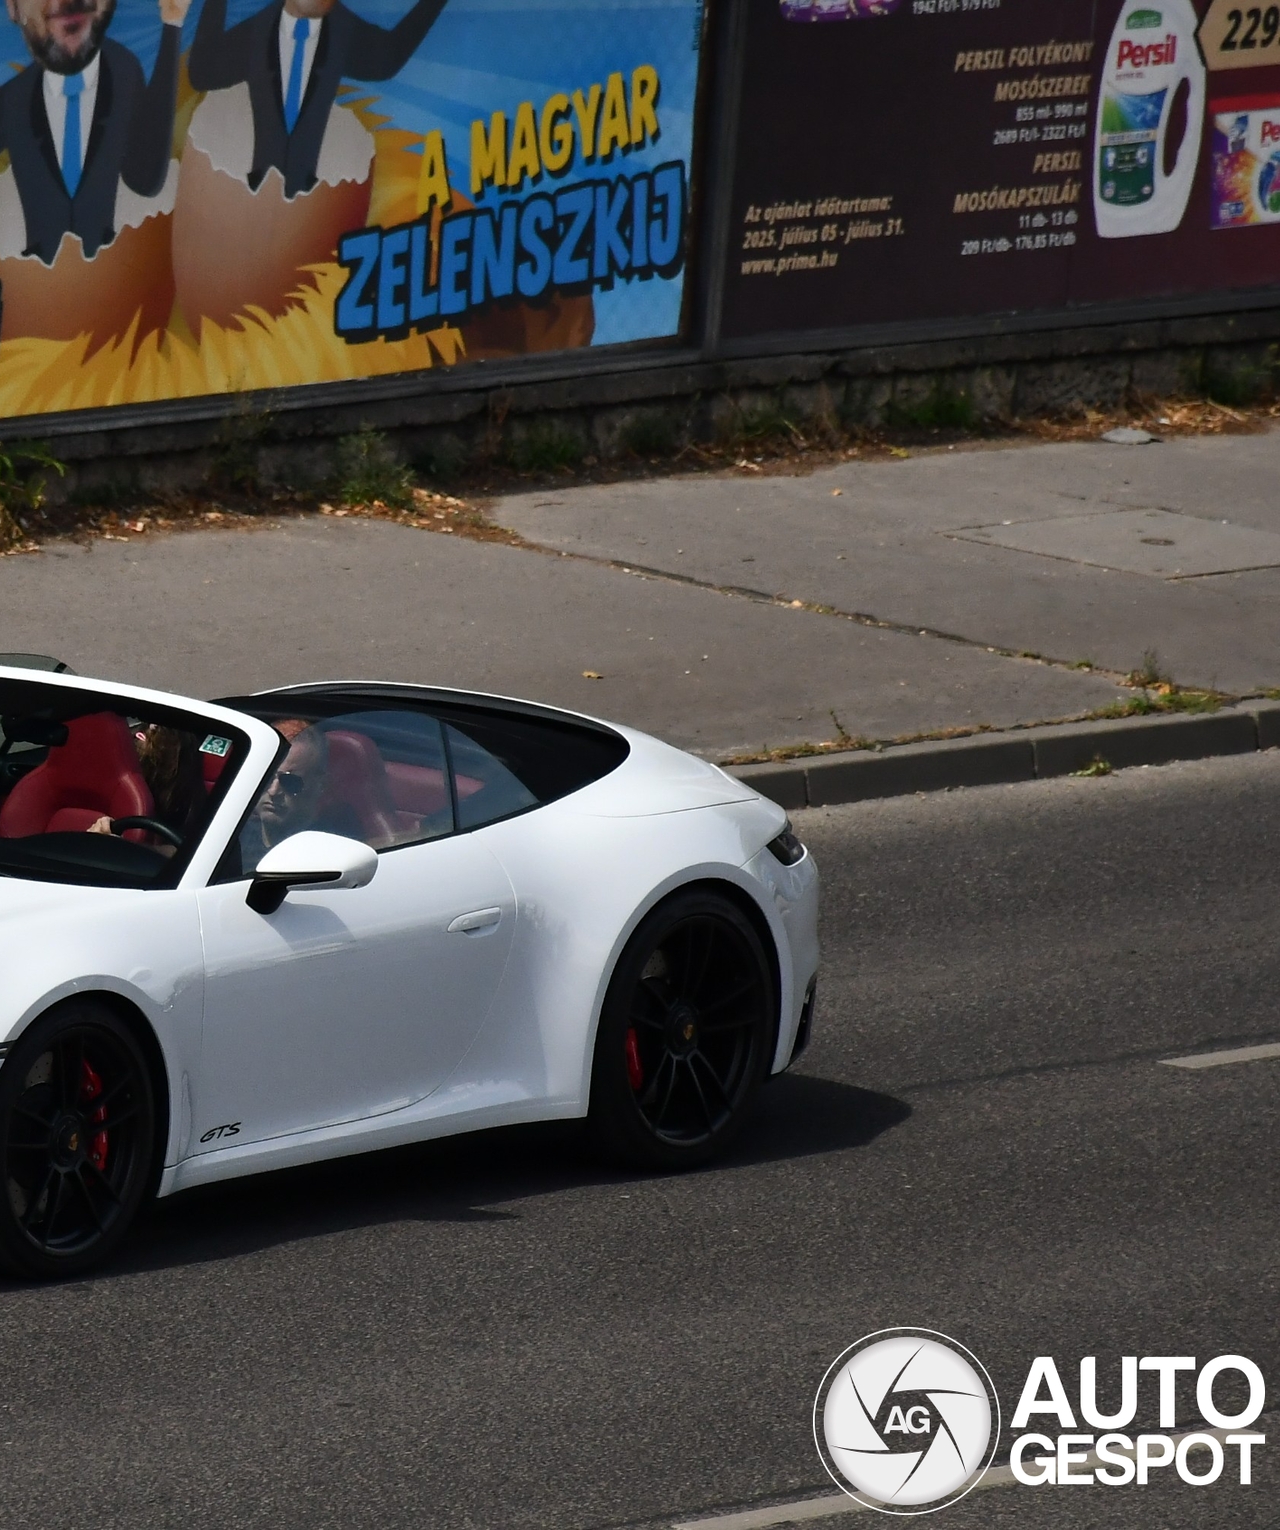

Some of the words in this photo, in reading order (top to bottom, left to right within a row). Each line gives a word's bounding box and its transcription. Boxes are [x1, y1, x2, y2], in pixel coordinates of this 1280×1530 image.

[1220, 5, 1280, 51] 229
[955, 49, 1005, 73] PERSIL
[1007, 40, 1095, 68] FOLYÉKONY
[1116, 33, 1178, 70] Persil
[994, 73, 1091, 102] MOSÓSZEREK
[418, 130, 453, 214] A
[469, 64, 661, 197] MAGYAR
[1032, 151, 1082, 174] PERSIL
[953, 177, 1082, 213] MOSÓKAPSZULÁK
[744, 205, 761, 223] Az
[764, 200, 812, 224] ajánlat
[1051, 211, 1062, 226] 13
[742, 230, 777, 249] 2025.
[778, 226, 818, 250] július
[821, 224, 837, 241] 05
[845, 219, 882, 245] július
[885, 218, 904, 236] 31.
[335, 164, 686, 338] ZELENSZKIJ
[741, 251, 838, 276] www.prima.hu
[200, 1121, 241, 1143] GTS
